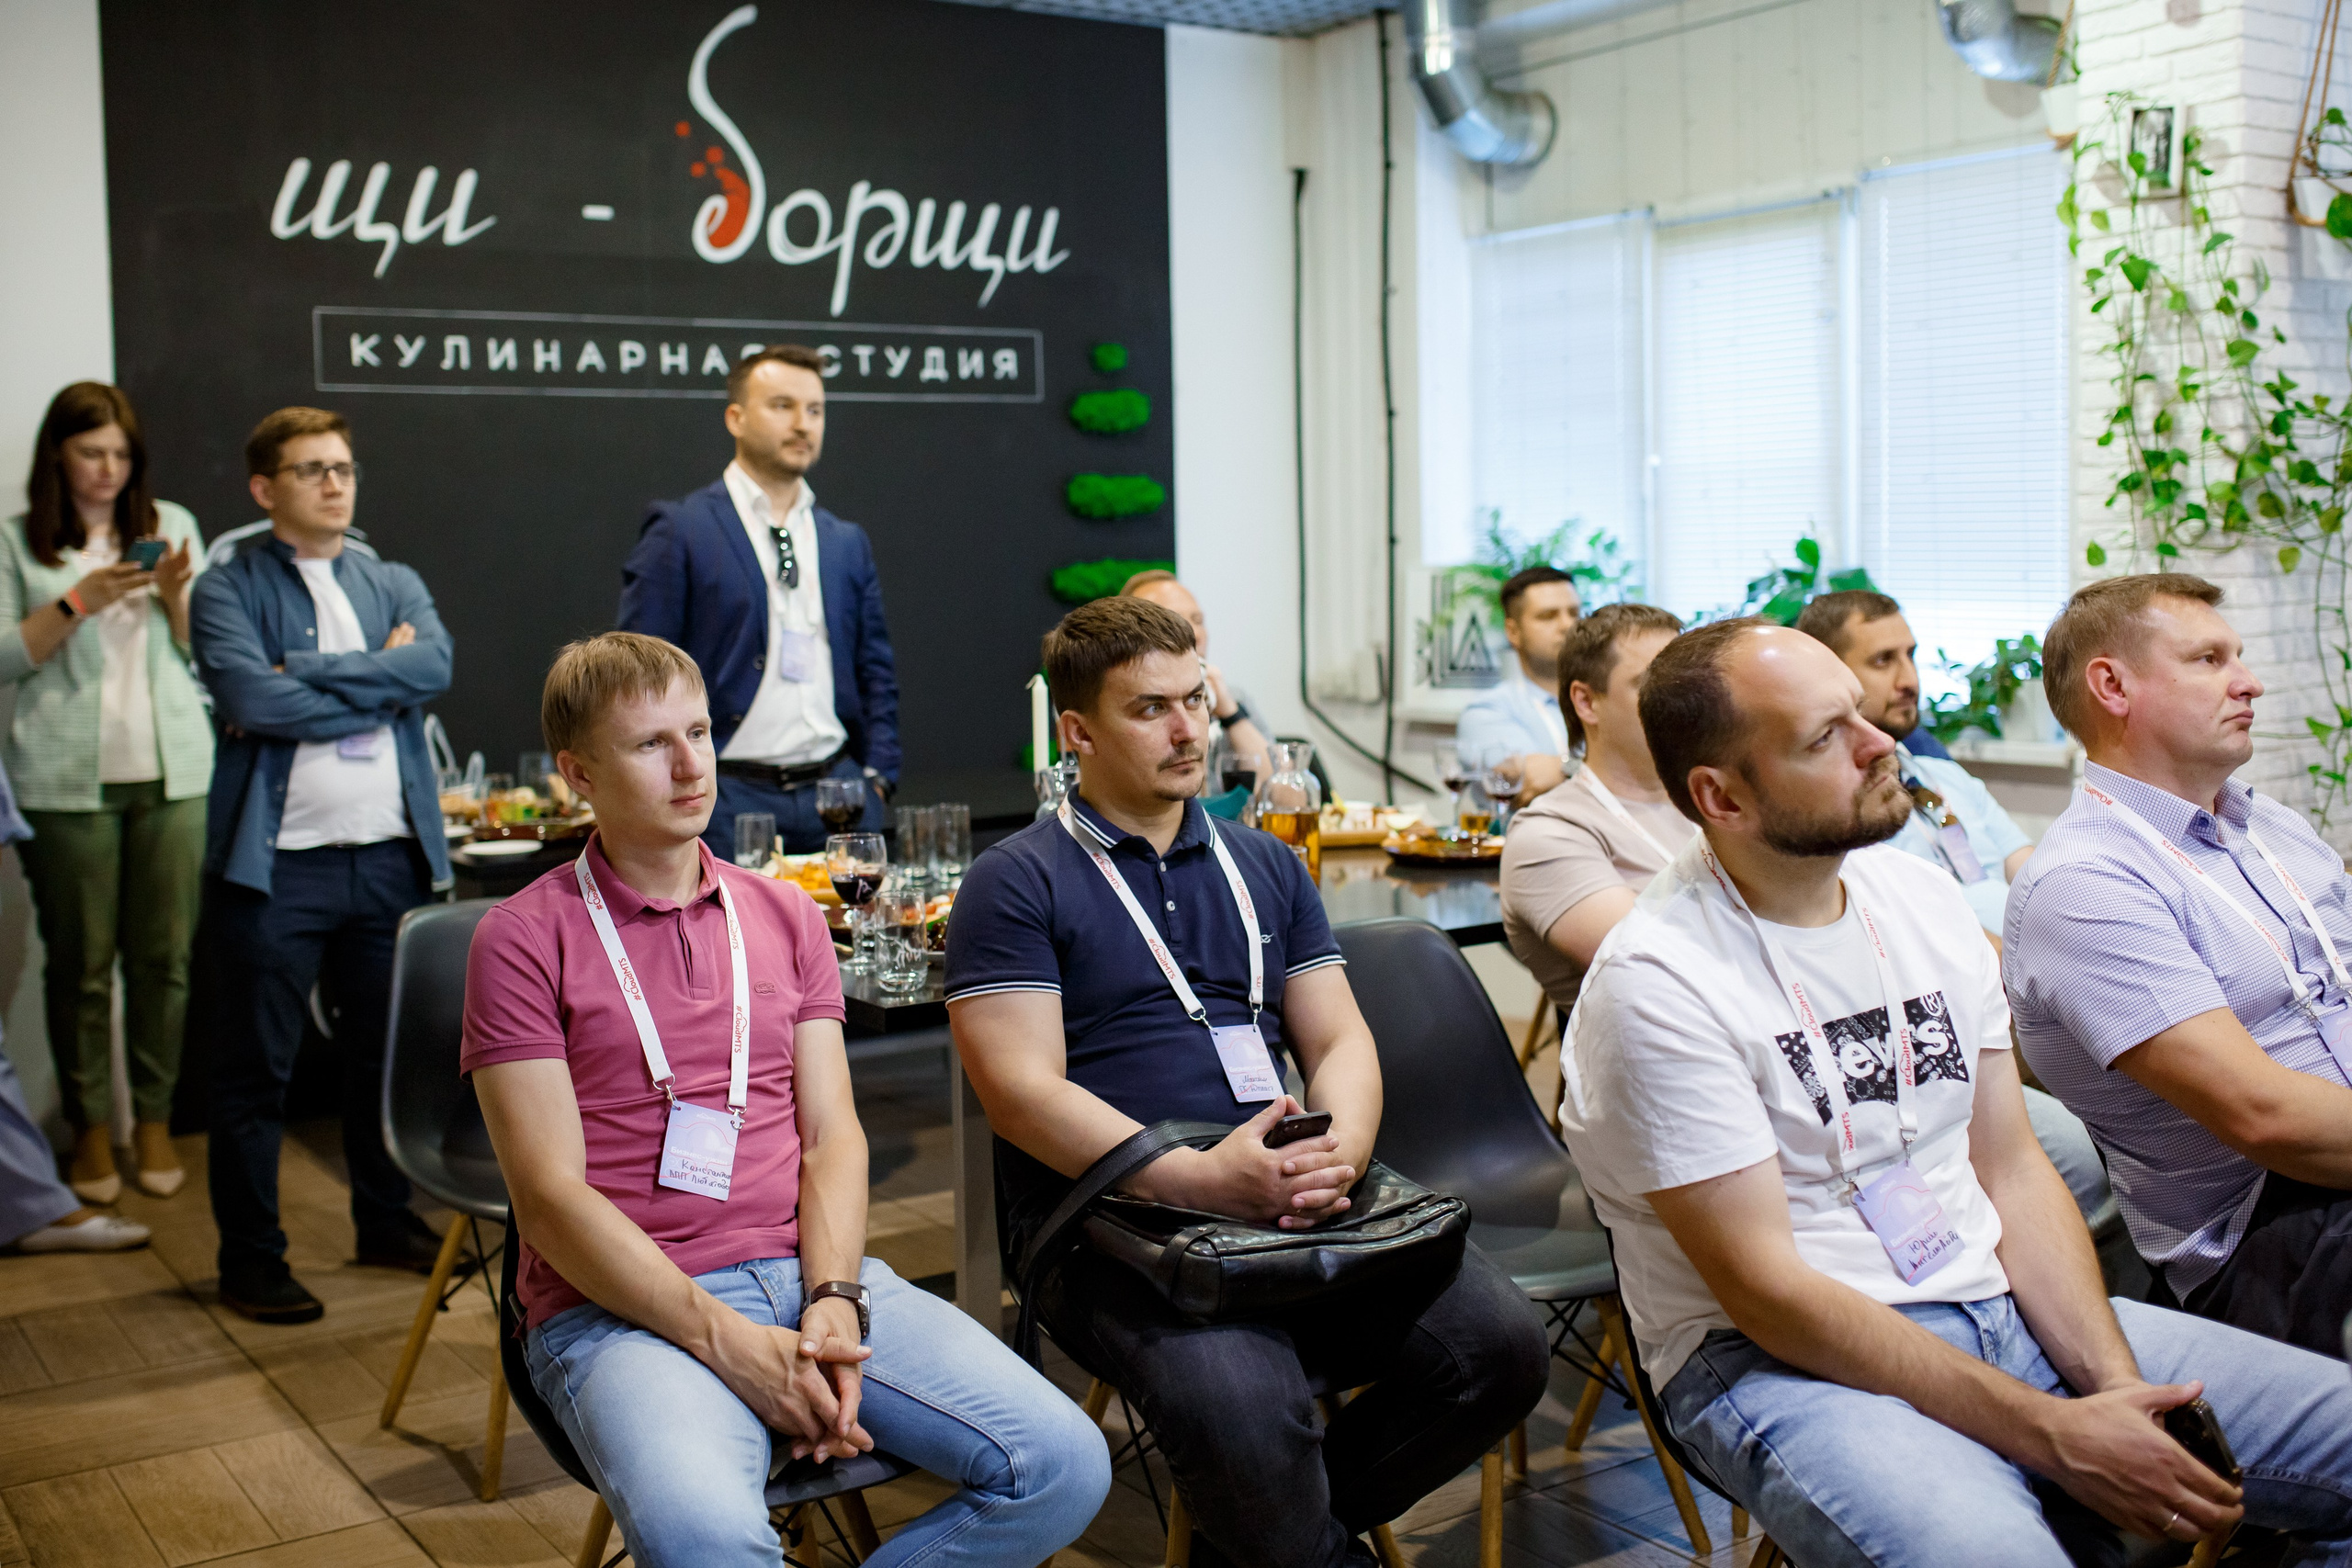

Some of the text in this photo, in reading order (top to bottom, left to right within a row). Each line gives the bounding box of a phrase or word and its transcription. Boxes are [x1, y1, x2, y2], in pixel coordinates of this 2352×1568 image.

[817, 344, 1019, 383] СТУДИЯ
[1092, 852, 1122, 890] #CloudMTS
[2162, 840, 2204, 874] #CloudMTS
[582, 872, 604, 910] #CloudMTS
[1862, 907, 1886, 959] #CloudMTS
[618, 957, 642, 1001] #CloudMTS
[1148, 937, 1177, 980] #CloudMTS
[734, 1005, 745, 1054] #CloudMTS
[1792, 982, 1822, 1039] #CloudMTS
[1899, 1028, 1913, 1087] #CloudMTS
[671, 1145, 728, 1165] Бизнес-ужин
